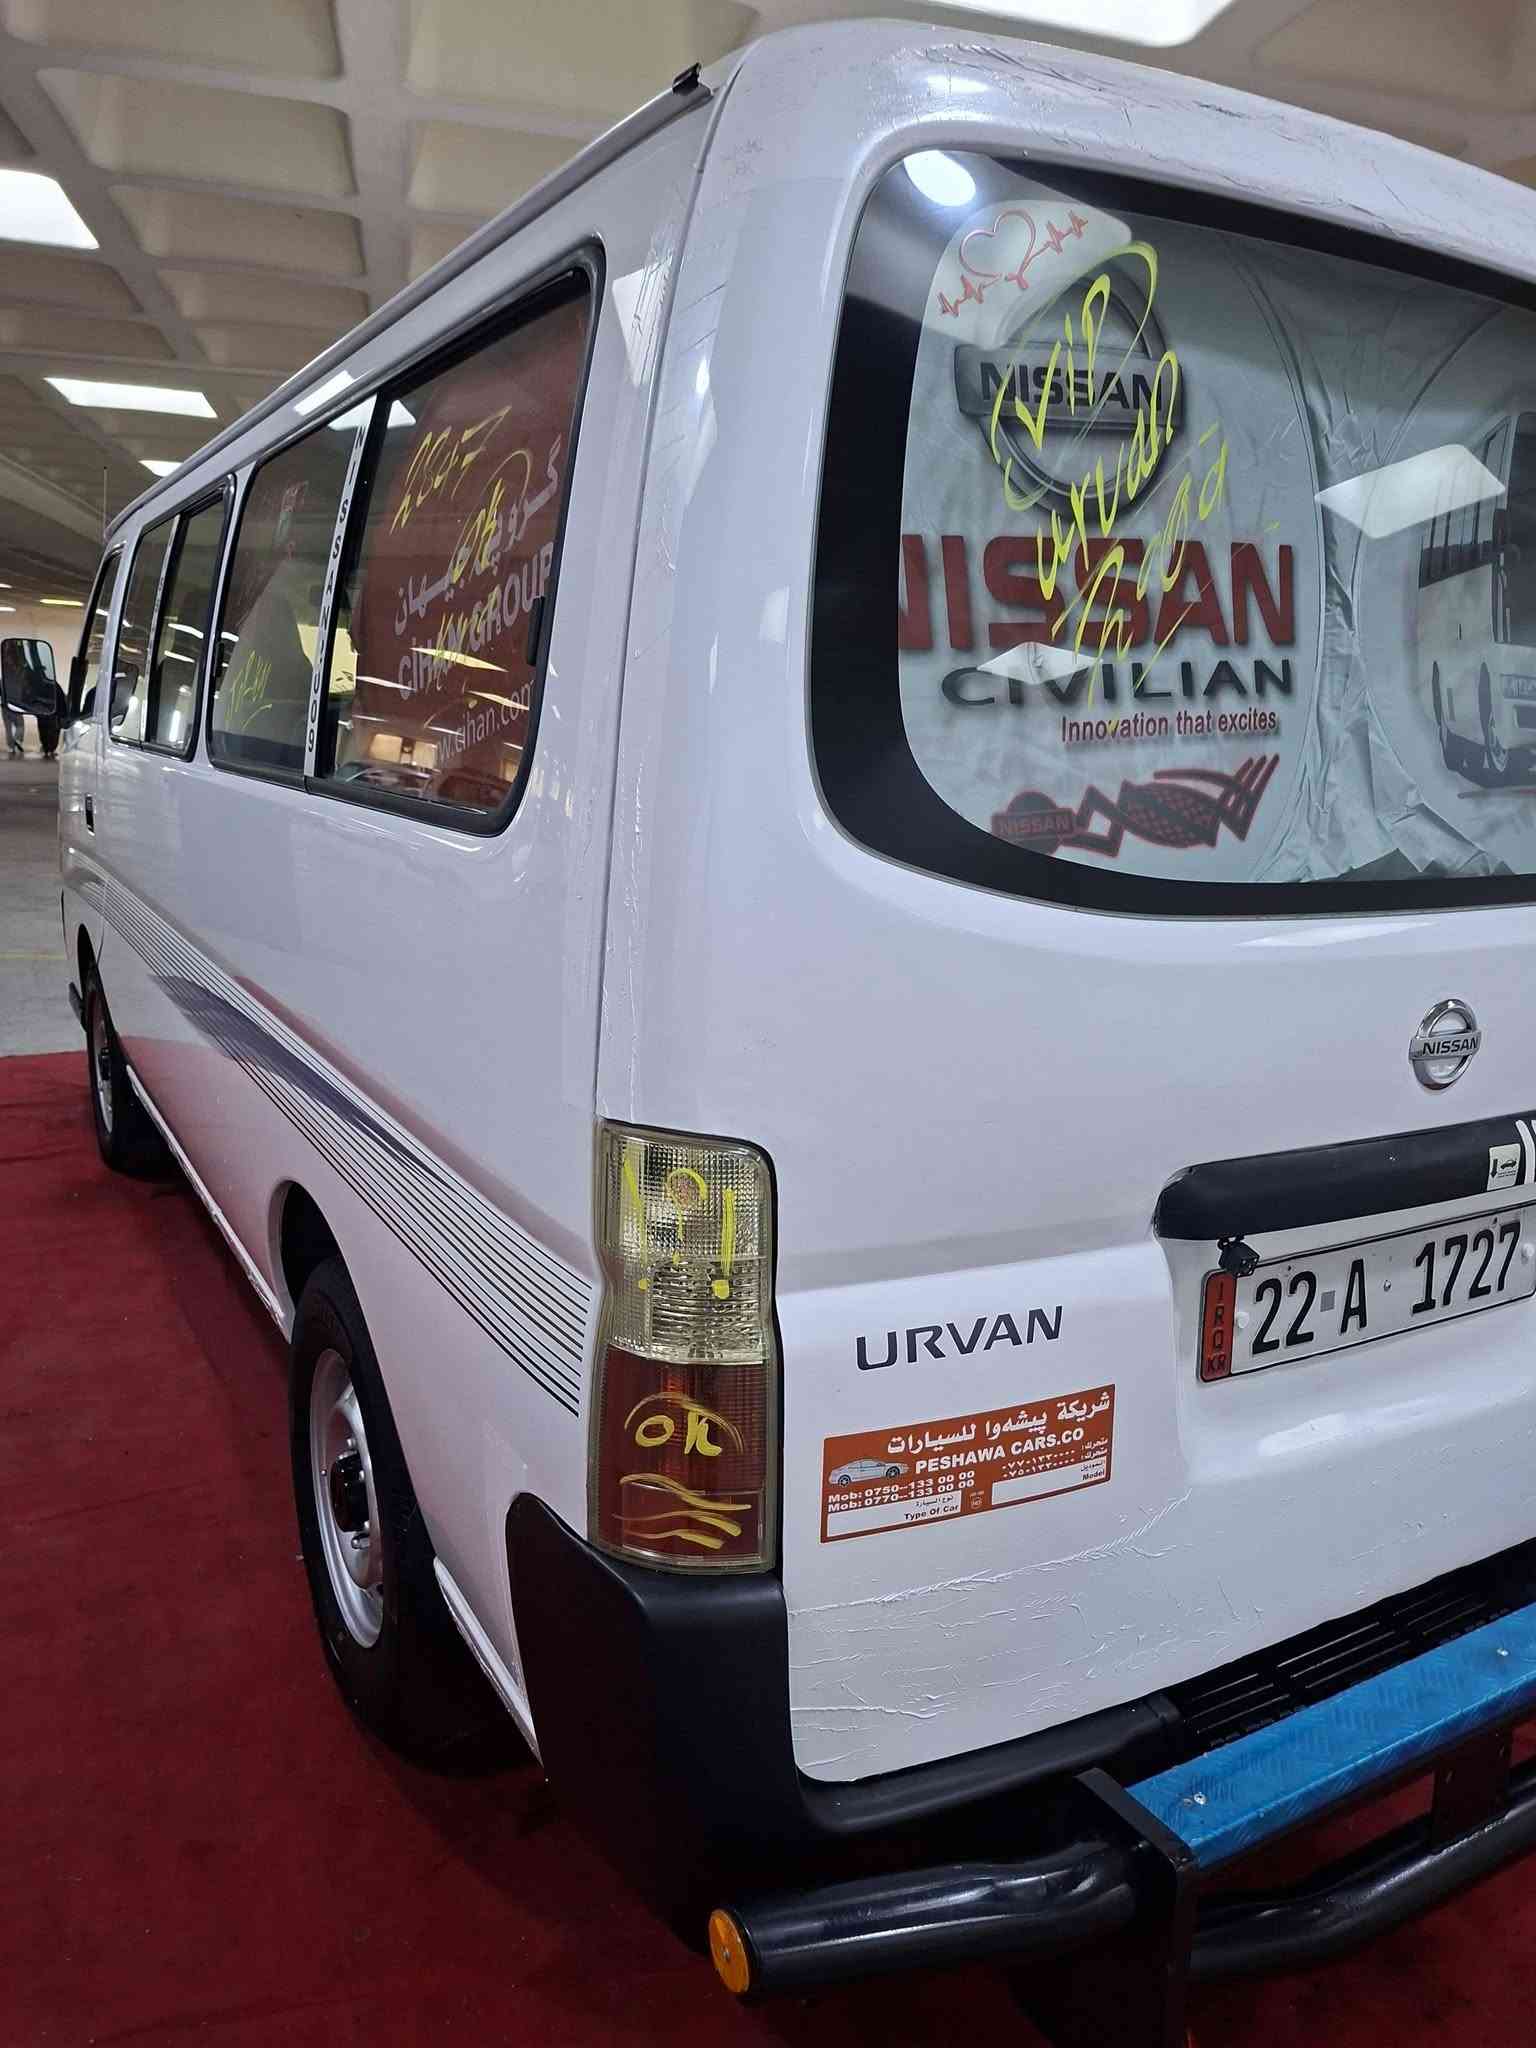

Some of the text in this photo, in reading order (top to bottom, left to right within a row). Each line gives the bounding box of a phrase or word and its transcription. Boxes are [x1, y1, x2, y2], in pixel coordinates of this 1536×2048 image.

[979, 361, 1163, 411] NISSAN
[941, 658, 1293, 706] CIVILIAN
[1061, 707, 1278, 744] Innovation that excites
[1421, 1036, 1479, 1056] NISSAN
[1251, 1222, 1521, 1355] 22 A 1727
[856, 1305, 1063, 1371] URVAN
[887, 1422, 977, 1454] للسيارات
[915, 1427, 1084, 1474] PESHAWA CARS.CO
[828, 1491, 863, 1503] Mob:
[938, 1475, 954, 1484] 00
[958, 1470, 975, 1480] 00
[1082, 1468, 1105, 1481] Model
[827, 1501, 863, 1512] Mob:
[938, 1483, 954, 1493] 00
[958, 1479, 975, 1489] 00
[904, 1504, 960, 1521] Type Of Car
